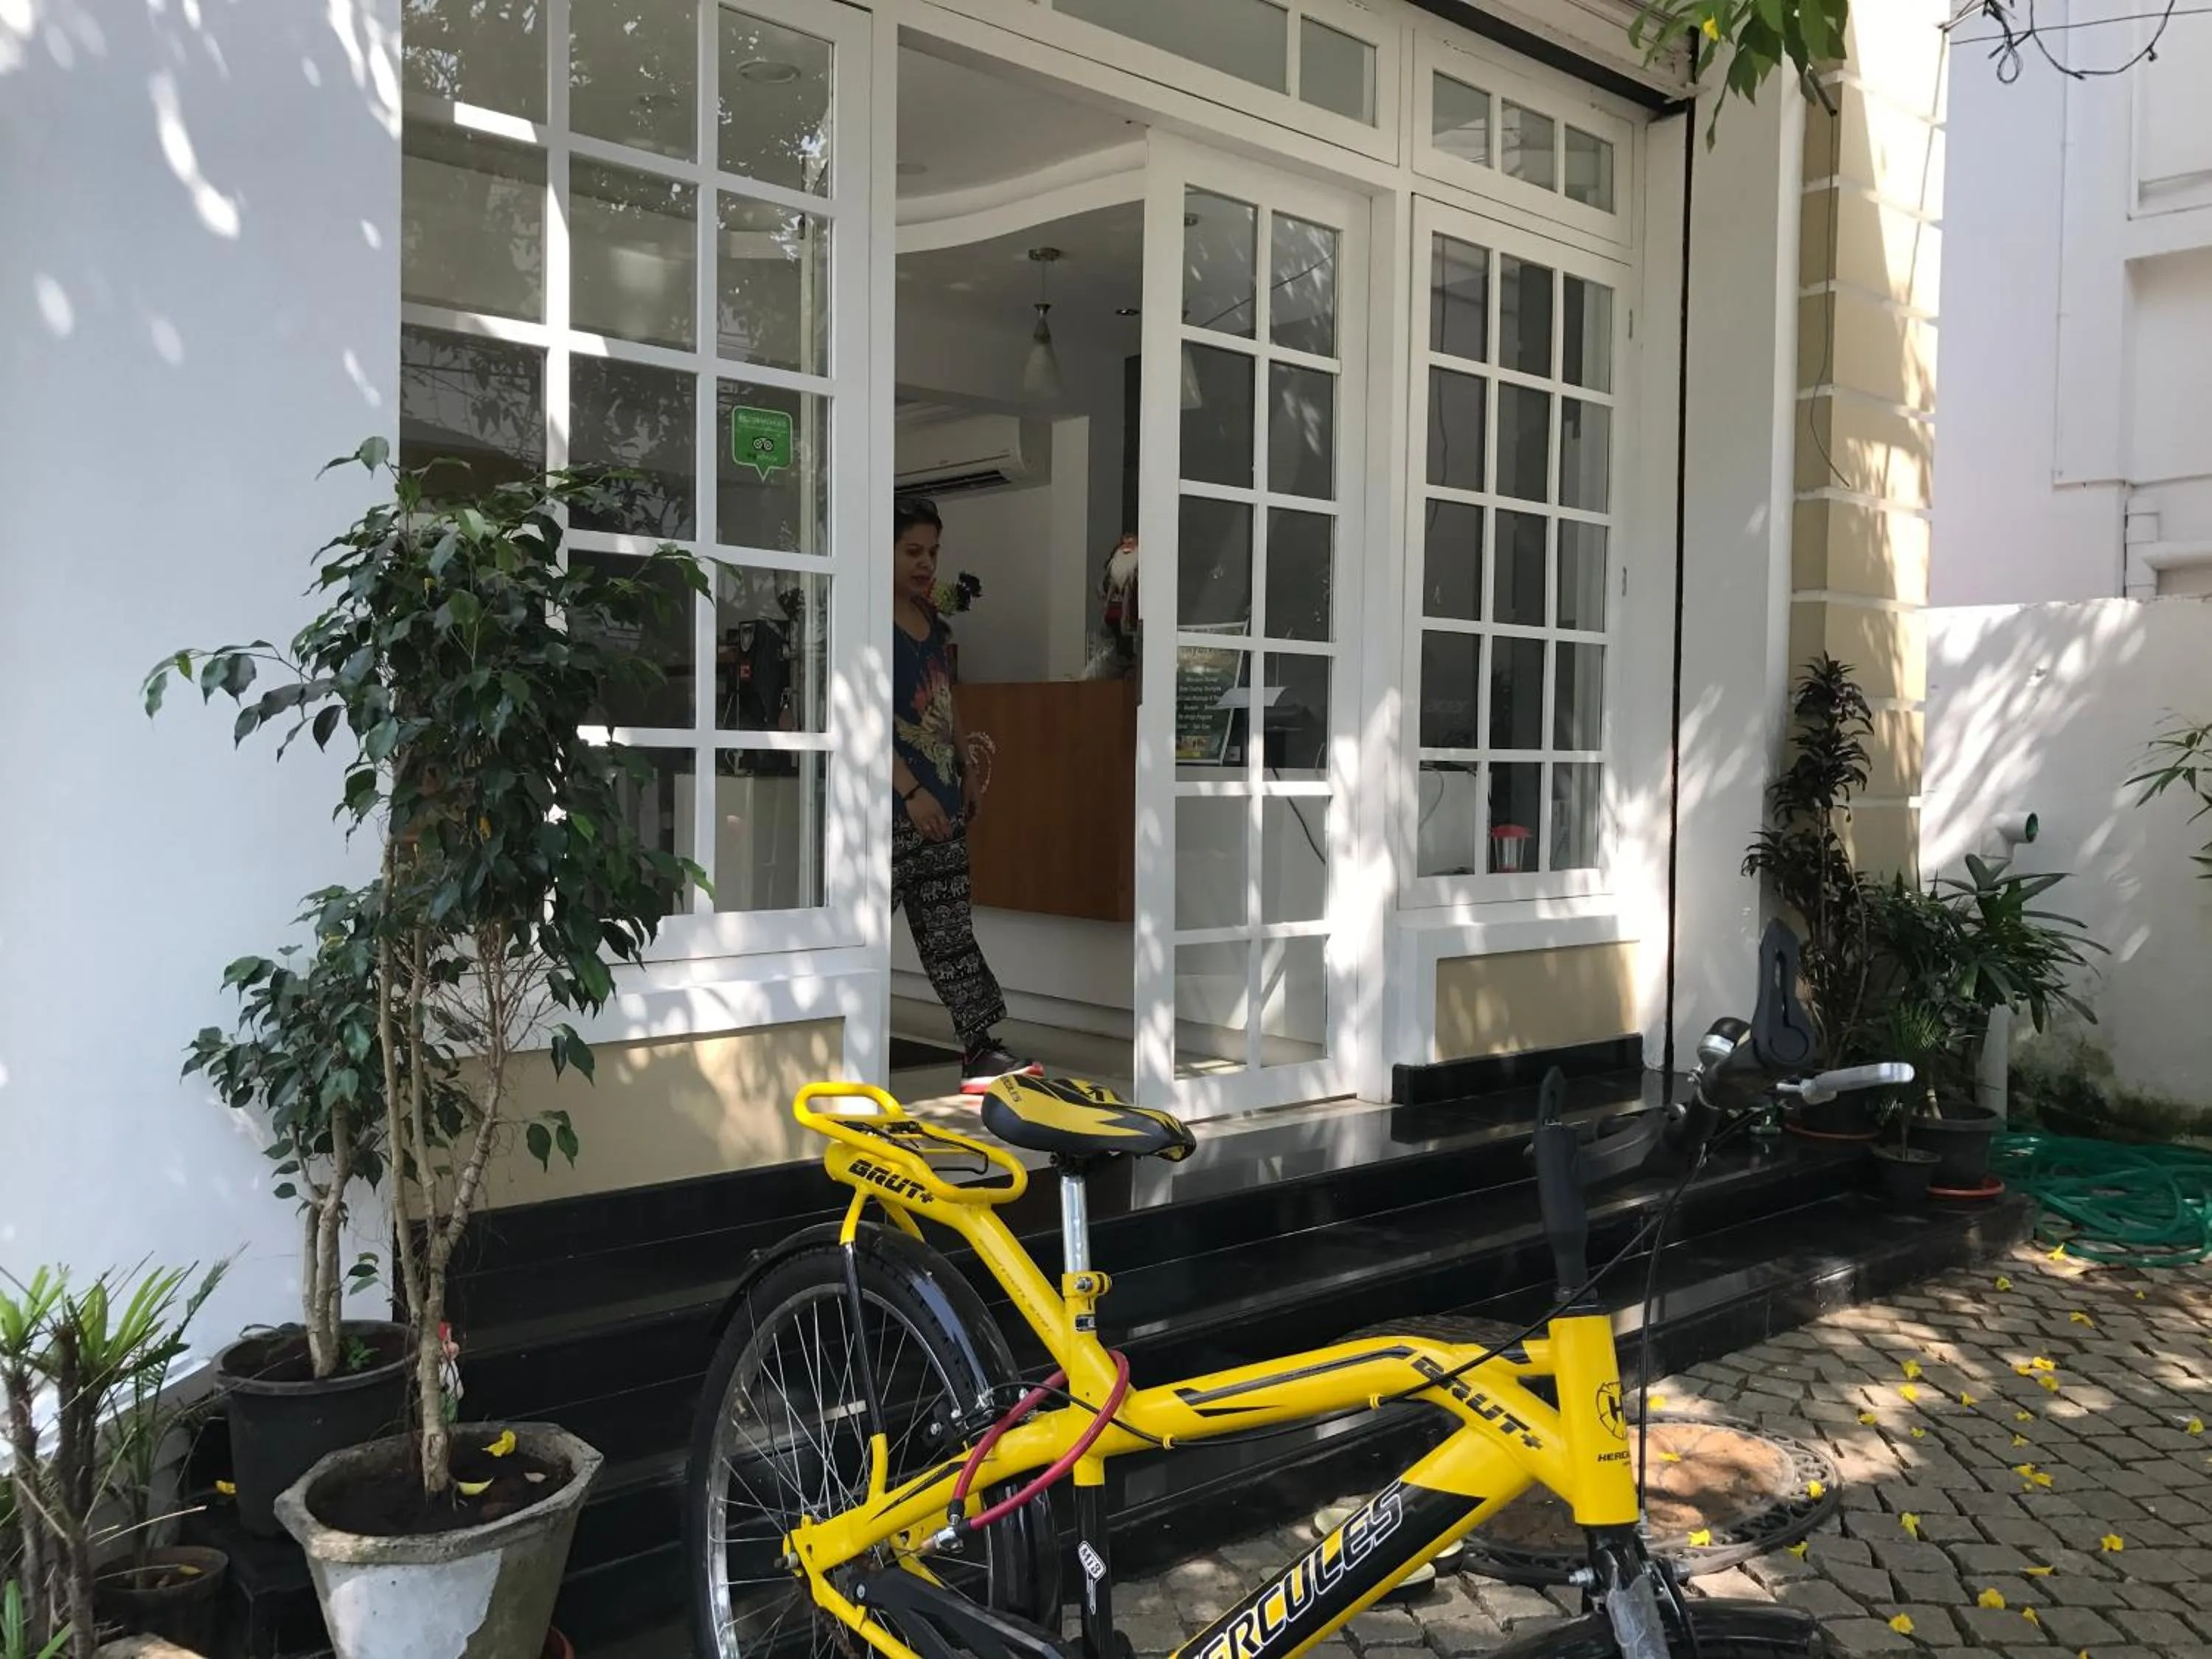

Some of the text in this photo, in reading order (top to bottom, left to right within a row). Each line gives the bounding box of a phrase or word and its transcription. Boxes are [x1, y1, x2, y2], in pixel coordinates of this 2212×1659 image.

[848, 1158, 935, 1205] BRUT+
[1597, 1450, 1630, 1462] HERC
[1193, 1476, 1403, 1659] ERCULES
